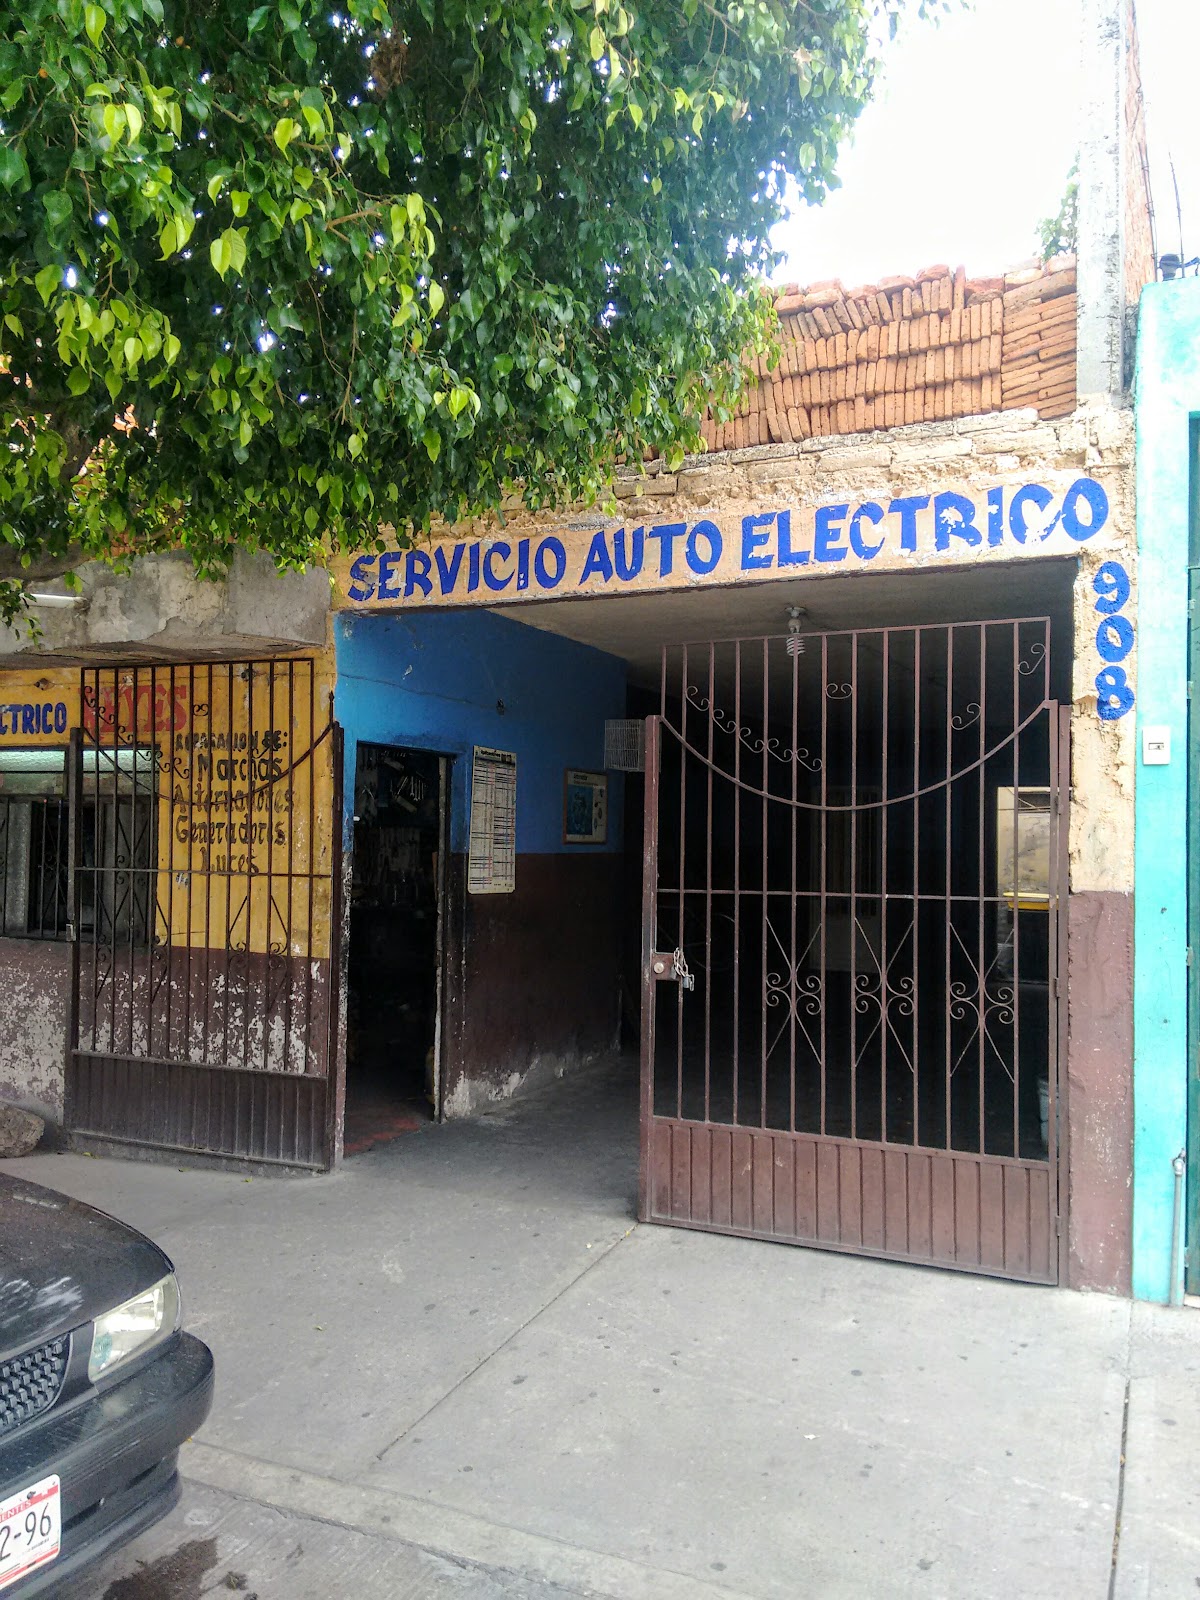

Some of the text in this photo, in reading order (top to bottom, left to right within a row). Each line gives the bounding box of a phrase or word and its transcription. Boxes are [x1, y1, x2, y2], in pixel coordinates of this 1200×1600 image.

[347, 477, 1109, 602] SERVICIO AUTO ELECTRICO
[1093, 561, 1135, 721] 908
[78, 685, 188, 740] REYES
[198, 753, 283, 781] Marchas
[173, 782, 295, 813] Aternadores
[199, 847, 260, 876] Luces
